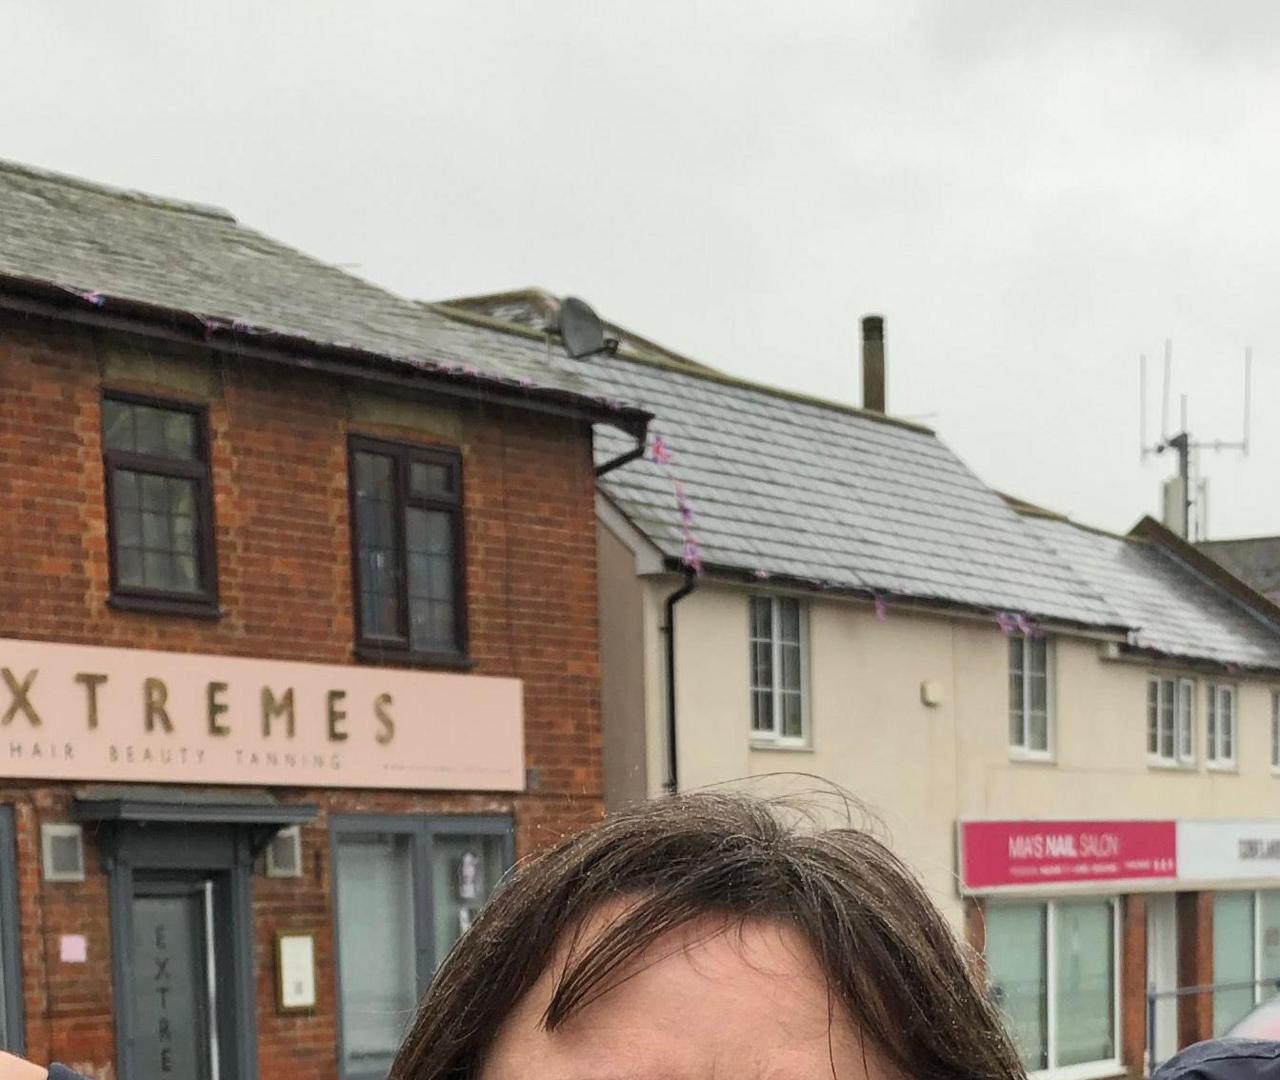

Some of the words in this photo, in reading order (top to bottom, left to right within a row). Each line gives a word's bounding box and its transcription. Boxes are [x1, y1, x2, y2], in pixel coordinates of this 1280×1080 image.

[9, 742, 75, 761] HAIR
[108, 744, 205, 766] BEAUTY
[234, 748, 343, 770] TANNING
[1045, 834, 1079, 858] NAIL
